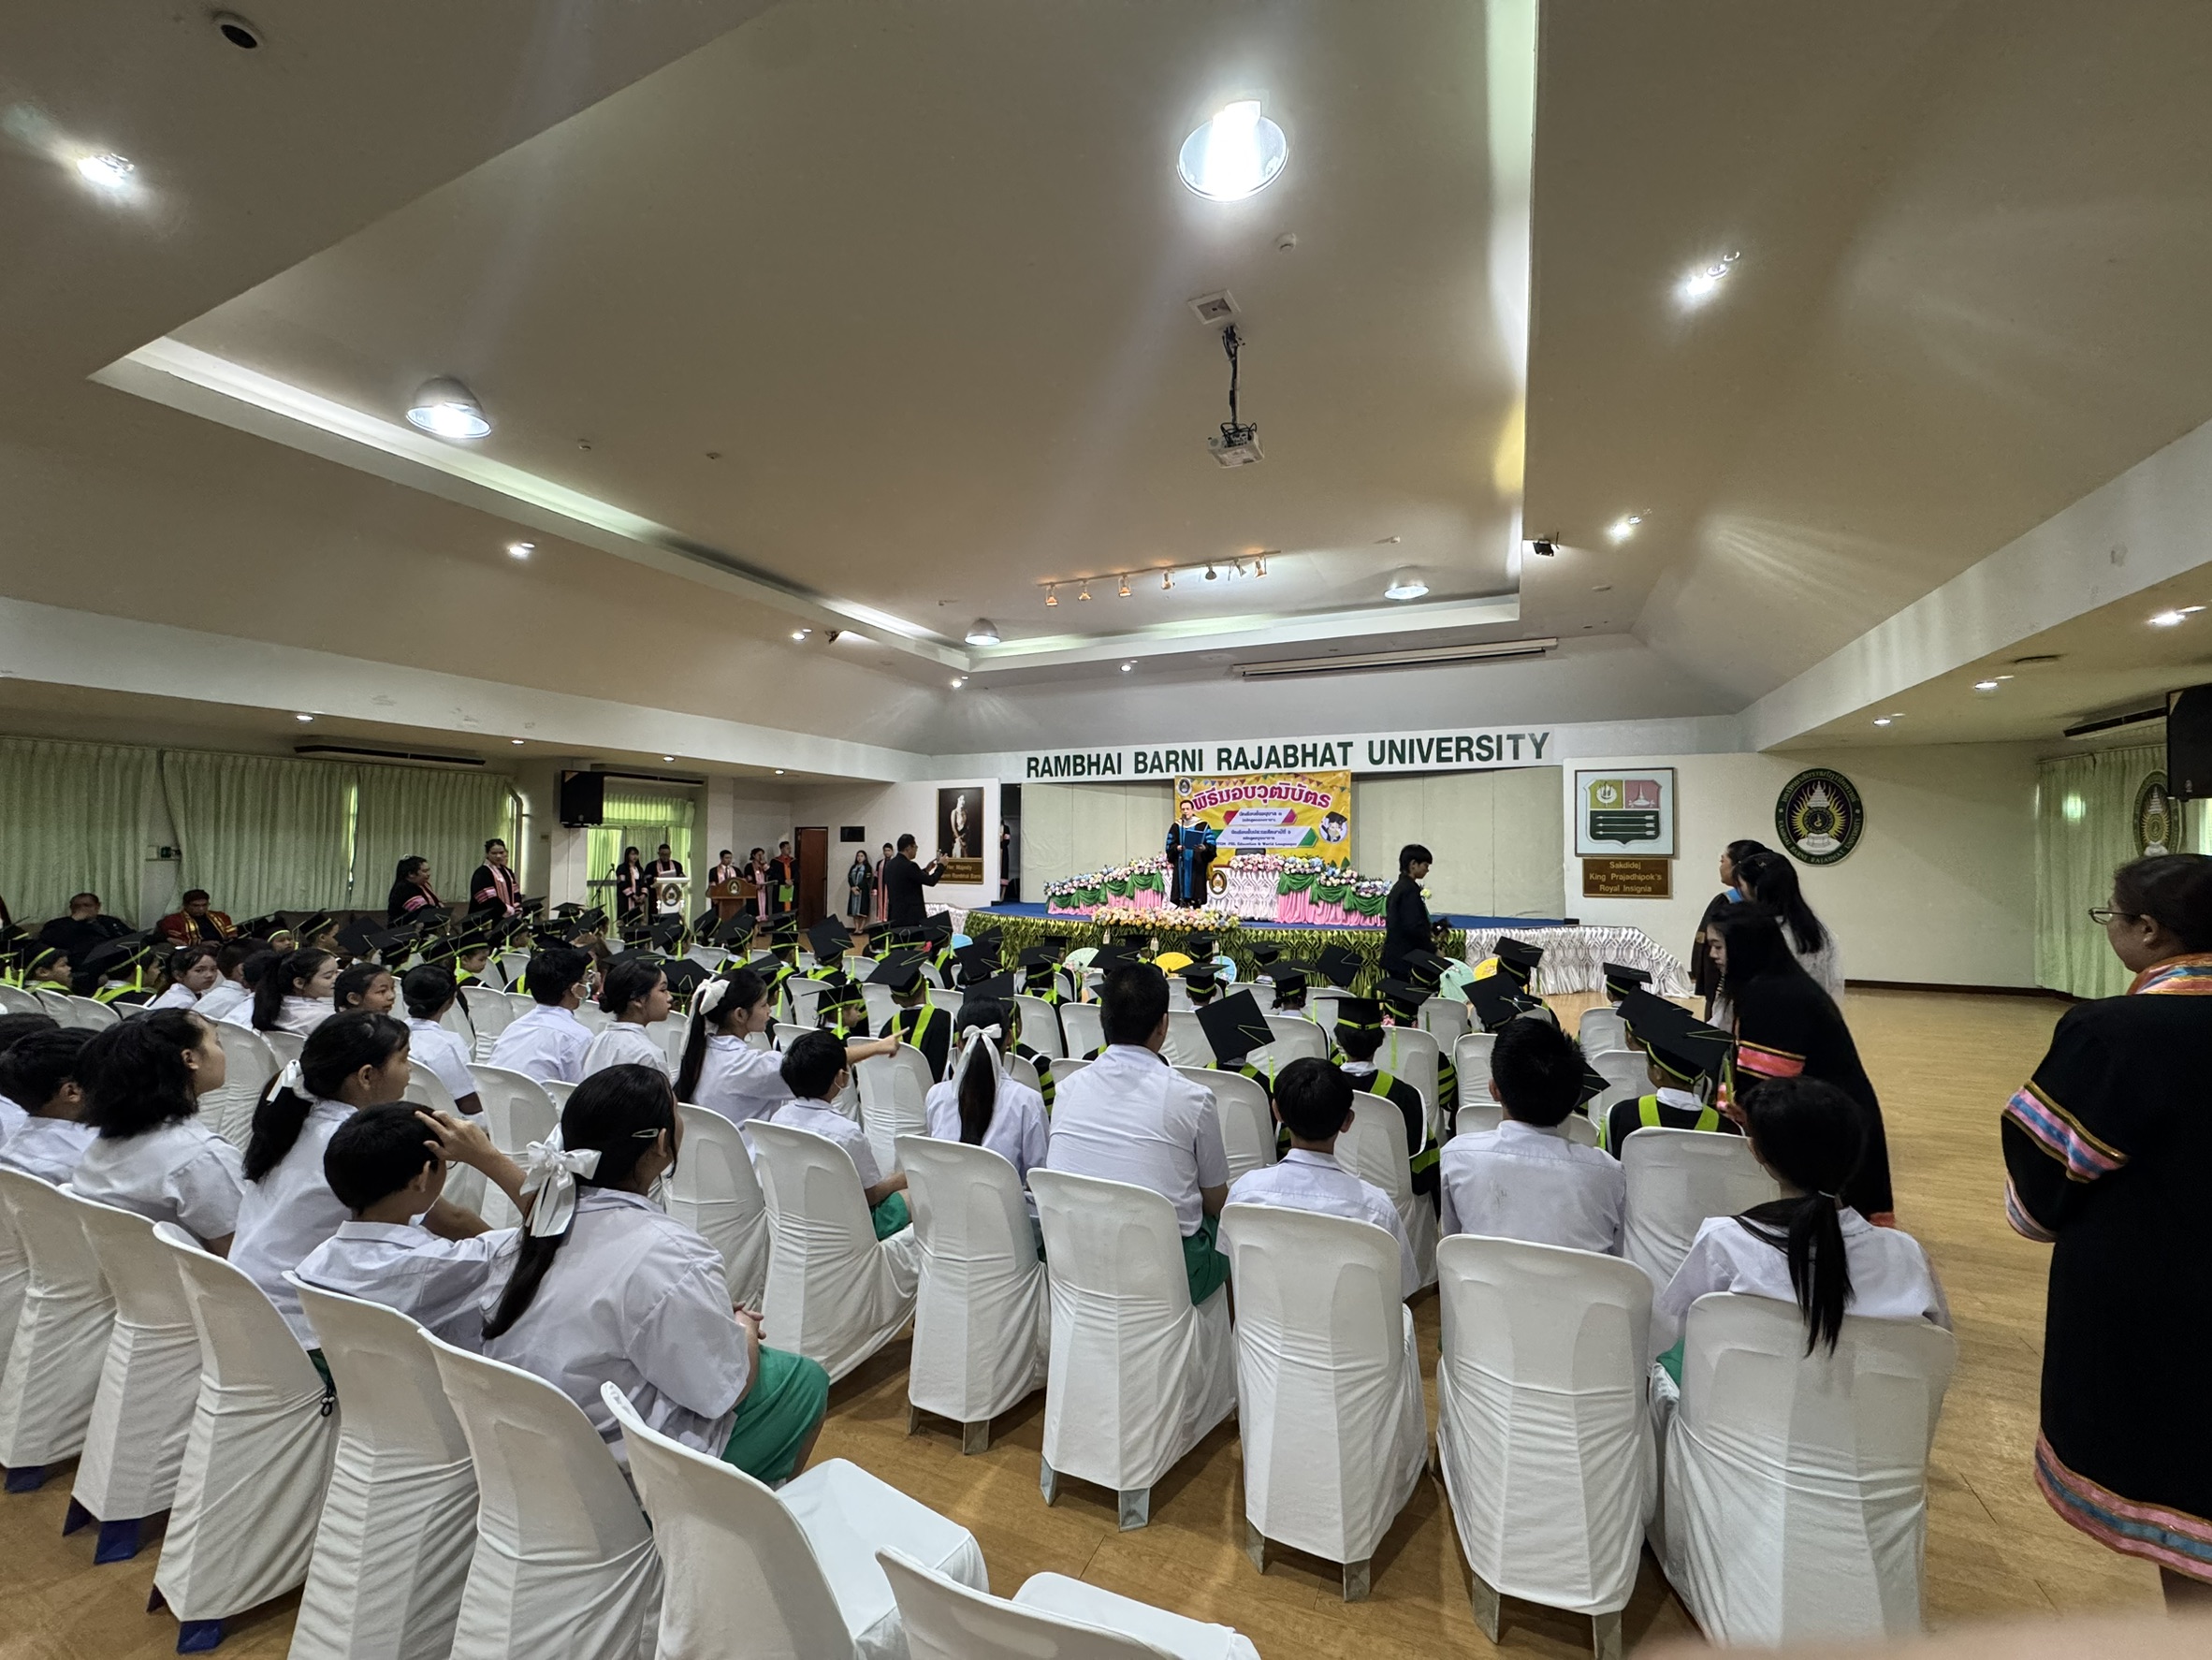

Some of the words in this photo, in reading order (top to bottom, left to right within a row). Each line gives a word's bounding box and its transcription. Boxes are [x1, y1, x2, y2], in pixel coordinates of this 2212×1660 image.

[1026, 752, 1122, 779] RAMBHAI
[1134, 749, 1203, 774] BARNI
[1216, 741, 1354, 771] RAJABHAT
[1368, 733, 1550, 765] UNIVERSITY
[1193, 782, 1332, 810] พิธีมอบวุฒิบัตร
[1589, 873, 1607, 881] King
[1610, 873, 1662, 881] Prajadhipok's
[1599, 884, 1620, 893] Royal
[1623, 884, 1652, 894] Insignia
